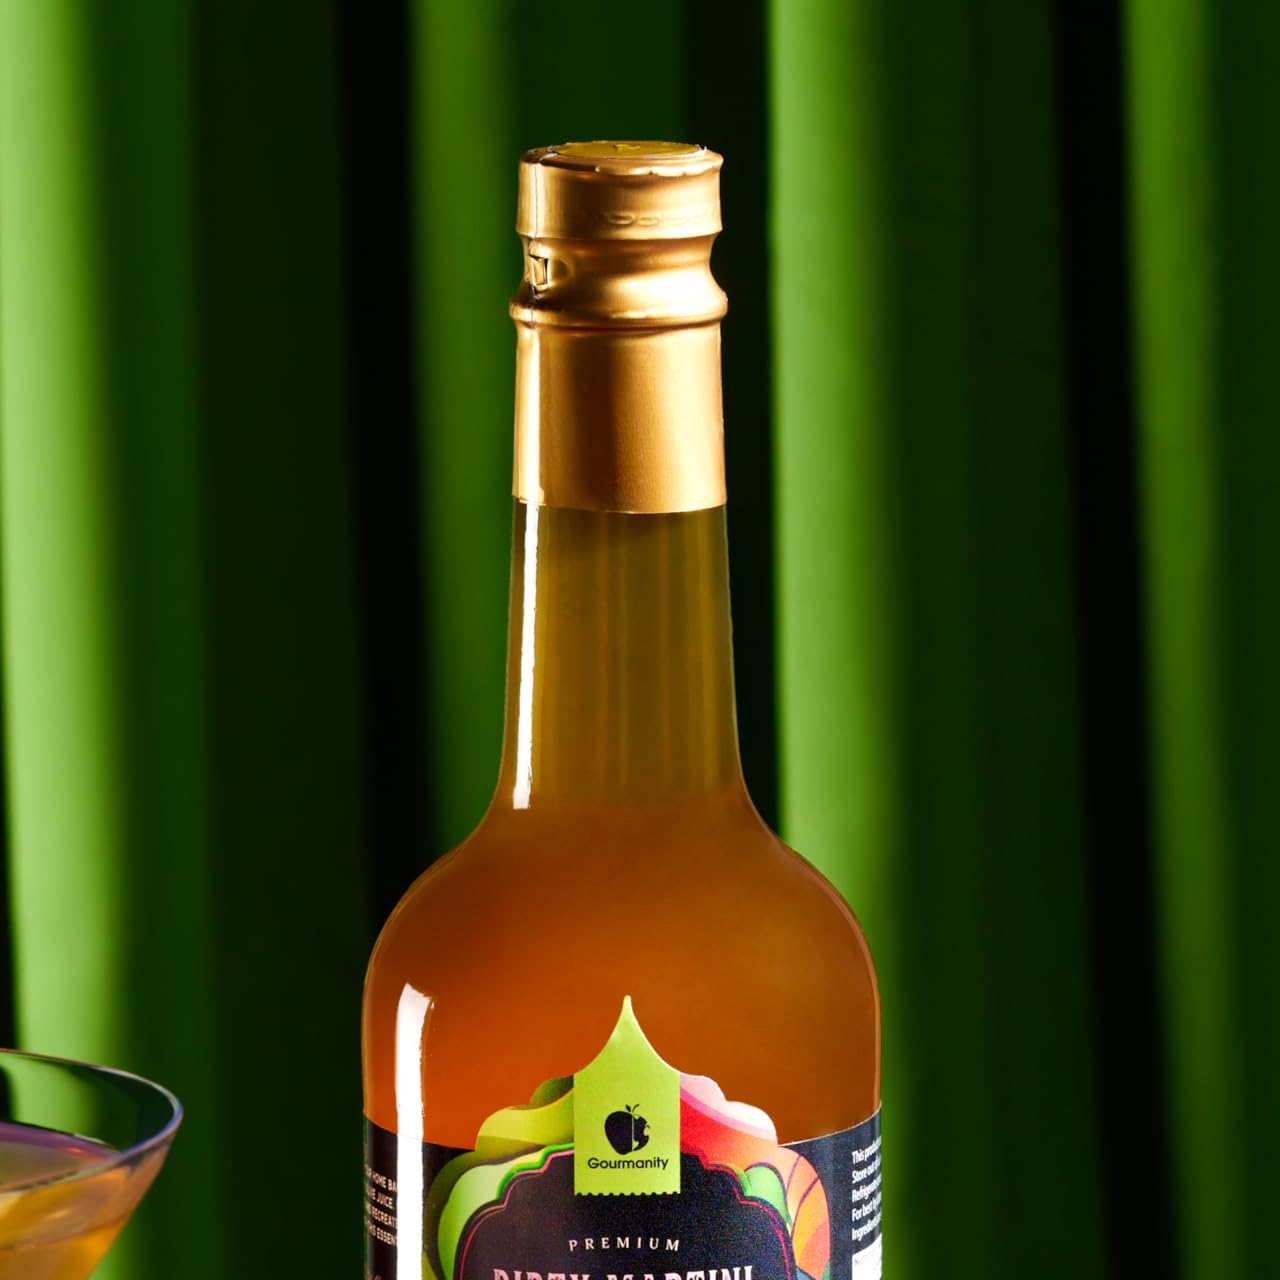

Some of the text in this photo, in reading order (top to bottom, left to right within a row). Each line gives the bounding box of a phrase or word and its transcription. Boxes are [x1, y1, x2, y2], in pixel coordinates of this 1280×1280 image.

[587, 1156, 669, 1171] Gourmanity
[851, 1148, 865, 1165] This
[851, 1207, 863, 1222] For
[568, 1236, 680, 1252] PREMIUM
